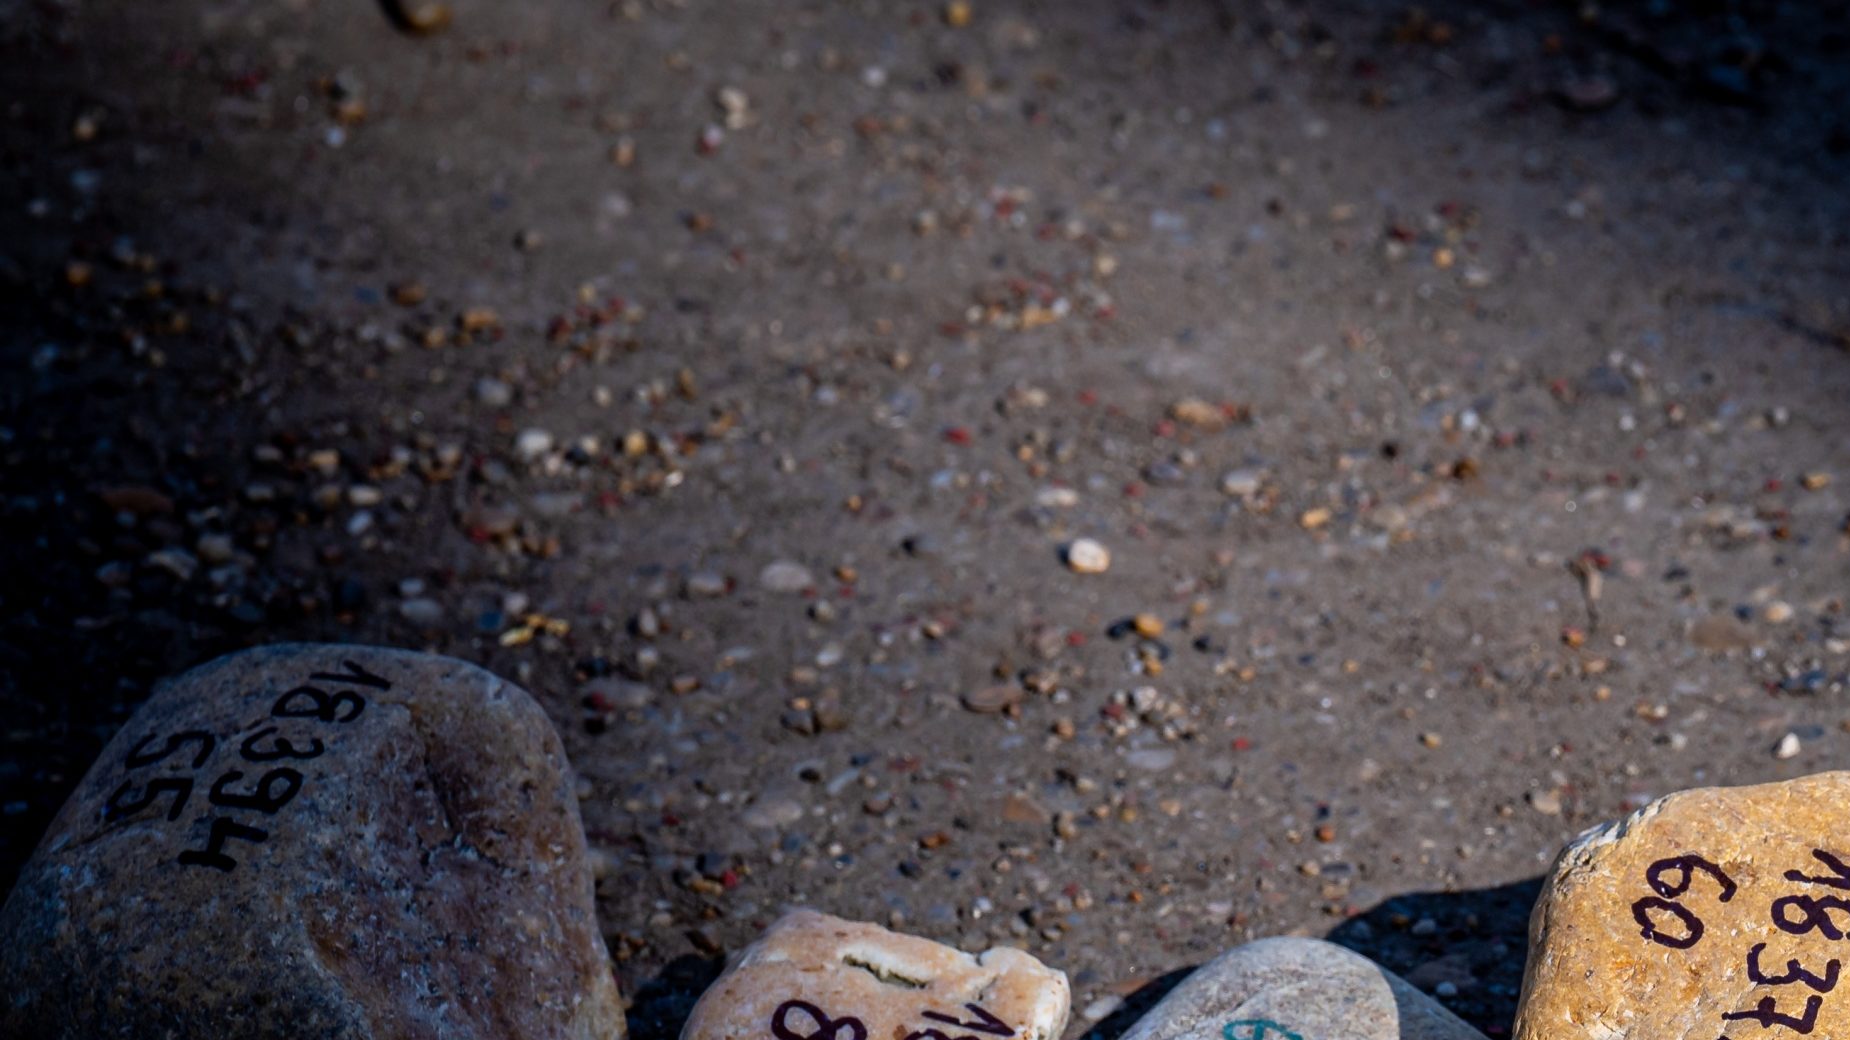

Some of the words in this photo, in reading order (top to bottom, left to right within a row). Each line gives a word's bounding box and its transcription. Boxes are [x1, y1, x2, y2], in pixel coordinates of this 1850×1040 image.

[104, 729, 216, 822] 55
[178, 661, 391, 872] 18394
[1631, 854, 1738, 950] 60
